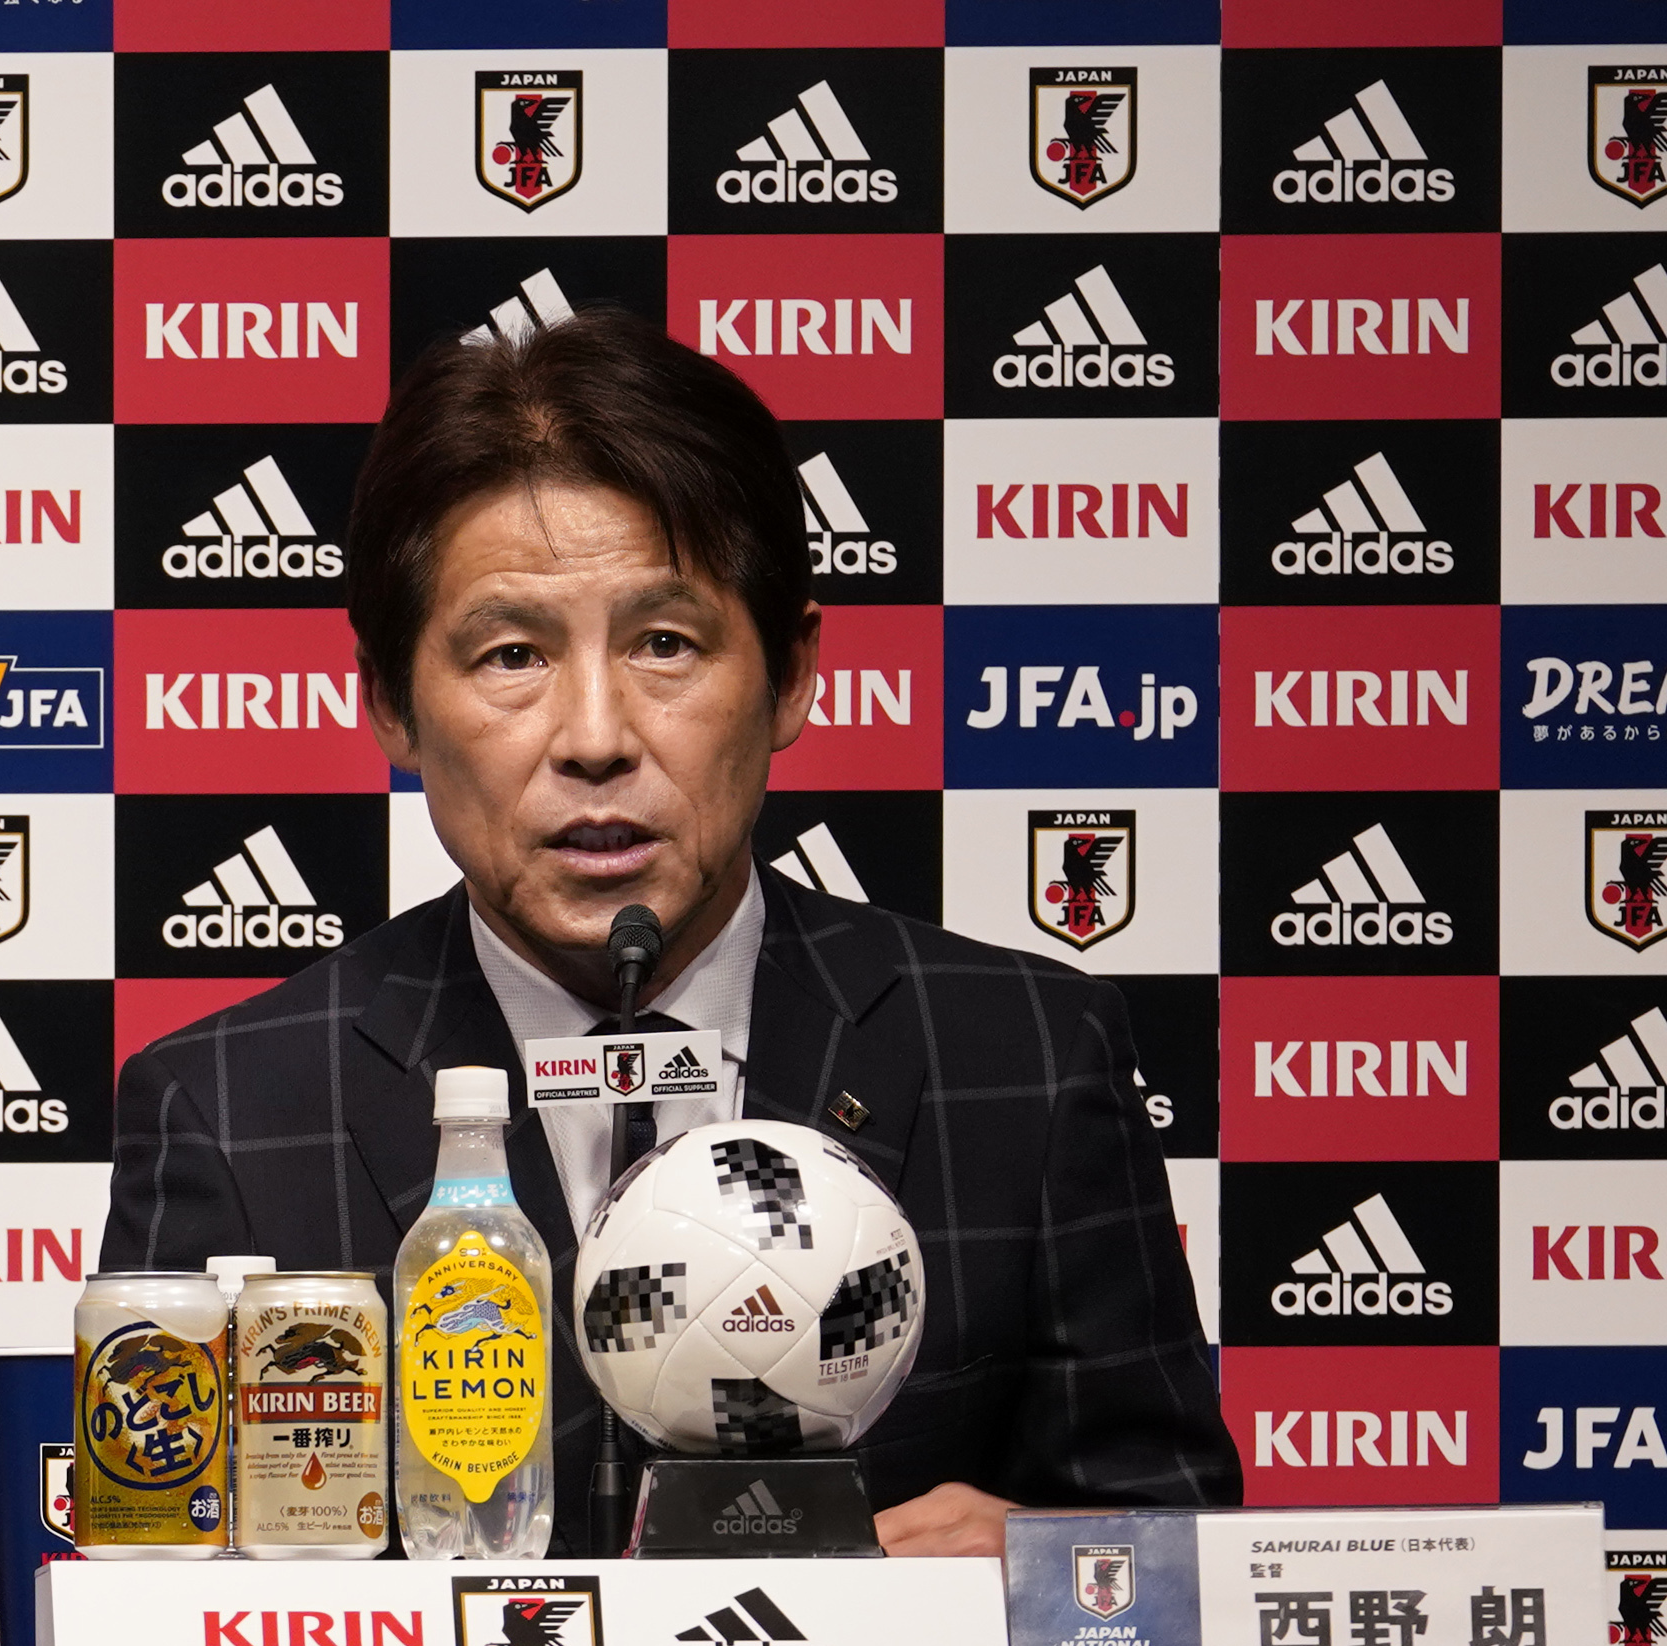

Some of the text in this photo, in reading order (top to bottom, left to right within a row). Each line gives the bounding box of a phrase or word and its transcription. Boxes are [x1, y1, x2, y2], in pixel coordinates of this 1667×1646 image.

[501, 74, 557, 85] JAPAN
[162, 164, 343, 207] adidas
[505, 167, 553, 187] JFA
[1273, 160, 1455, 203] adidas
[146, 302, 357, 359] KIRIN
[993, 344, 1174, 387] adidas
[977, 484, 1188, 538] KIRIN
[967, 665, 1198, 741] JFA.jp
[1255, 670, 1467, 726] KIRIN
[1054, 813, 1110, 824] JAPAN
[1057, 905, 1105, 926] JFA
[1271, 902, 1453, 945] adidas
[535, 1059, 596, 1077] KIRIN
[658, 1066, 709, 1080] adidas
[536, 1089, 598, 1099] OFFICIAL PARTNER
[653, 1083, 716, 1093] OFFICIAL SUPPLIER
[437, 1184, 508, 1199] キリンレモン
[427, 1261, 520, 1284] ANNIVERSARY
[293, 1301, 351, 1322] PRIME
[354, 1311, 382, 1358] BREW
[722, 1315, 795, 1333] adidas
[423, 1349, 524, 1369] KIRIN
[819, 1355, 869, 1376] TELSTAR
[413, 1378, 535, 1400] LEMON
[90, 1372, 215, 1442] のどごし
[249, 1392, 376, 1413] KIRIN BEER
[273, 1428, 352, 1448] 一番搾り
[1255, 1411, 1467, 1466] KIRIN
[432, 1451, 519, 1473] KIRIN BEVERAGE
[713, 1514, 797, 1535] adidas
[1251, 1540, 1341, 1553] SAMURAI
[1347, 1540, 1396, 1552] BLUE
[1250, 1563, 1284, 1578] 監督
[487, 1578, 566, 1590] JAPAN
[1074, 1626, 1137, 1640] JAPAN
